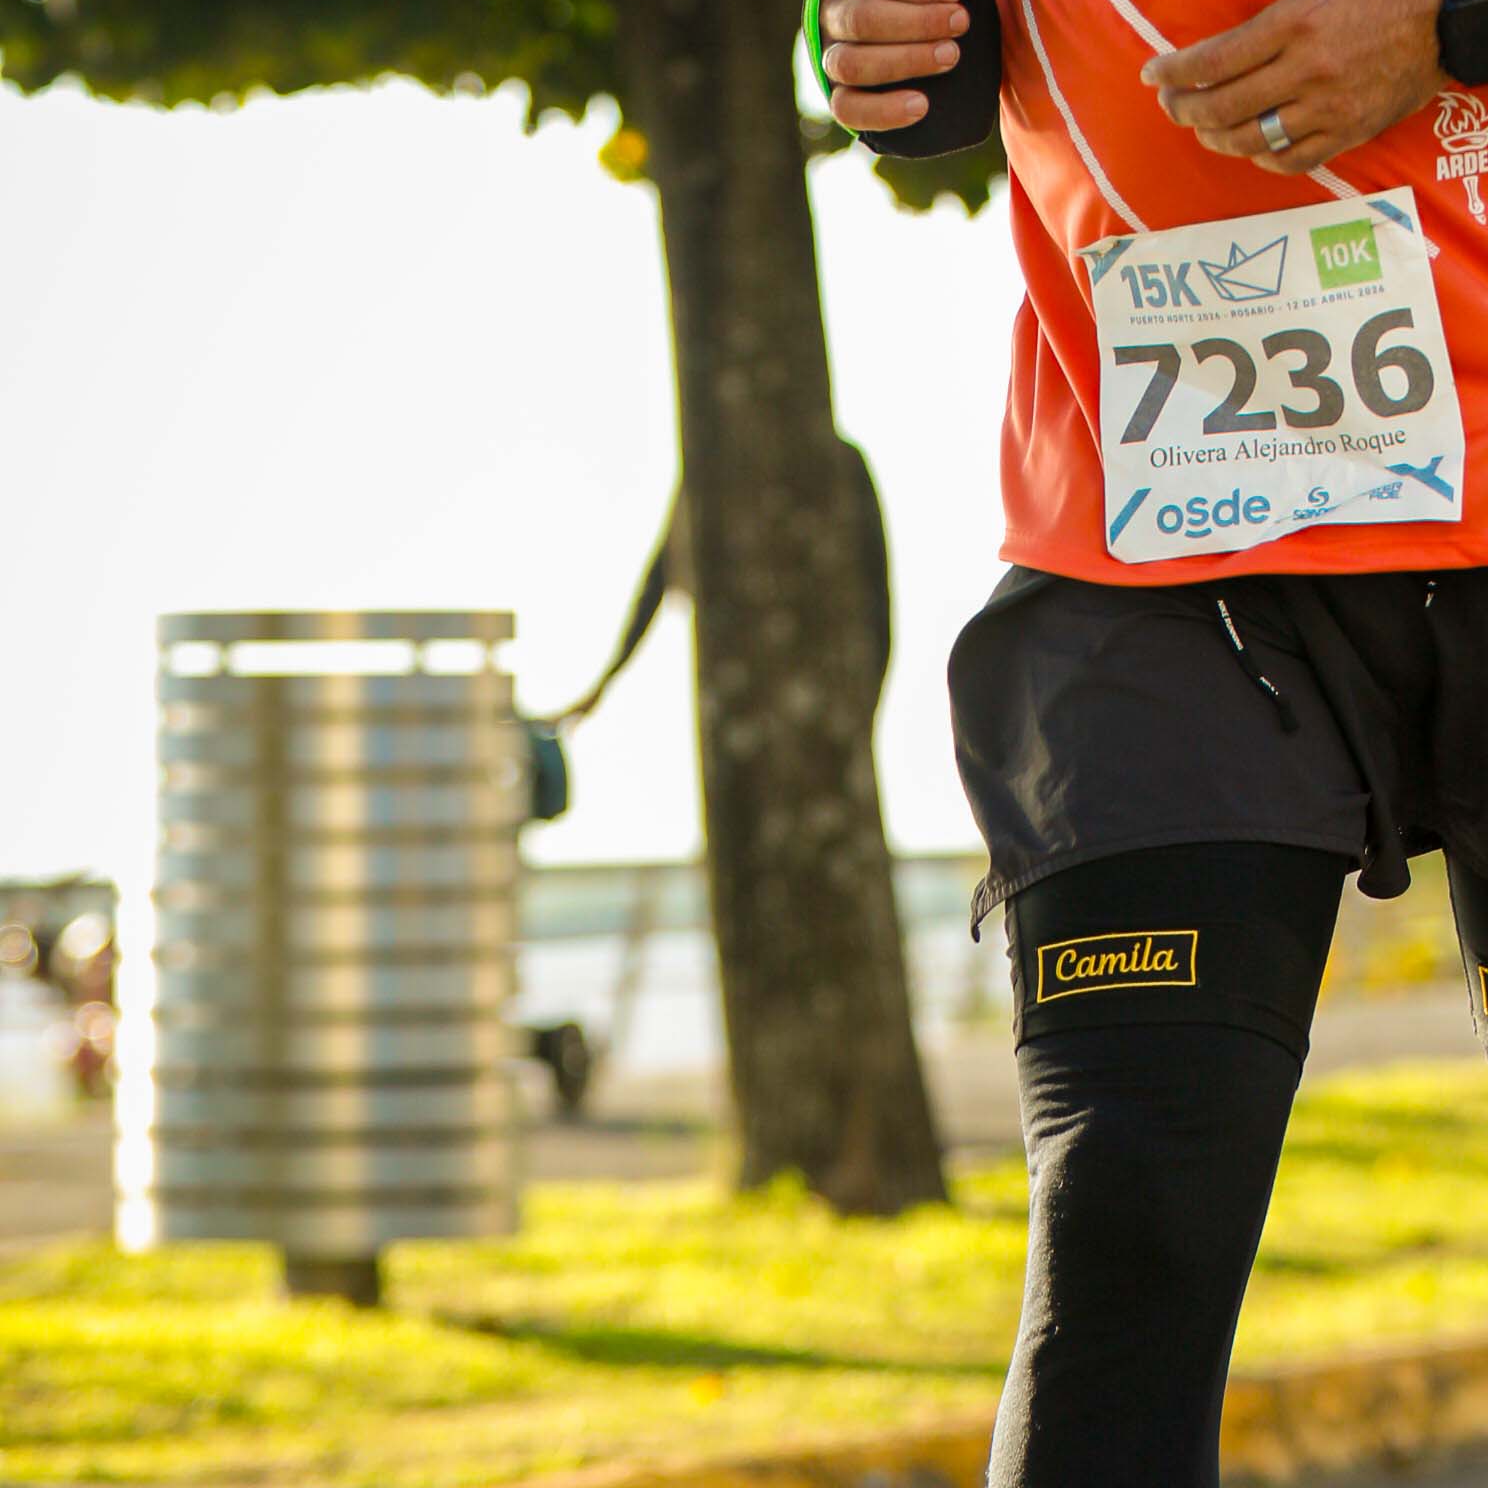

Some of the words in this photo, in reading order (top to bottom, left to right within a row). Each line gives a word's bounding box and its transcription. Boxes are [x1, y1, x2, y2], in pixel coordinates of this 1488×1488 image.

[1320, 238, 1373, 271] 10K
[1120, 262, 1202, 308] 15K
[1130, 315, 1164, 325] PUERTO
[1167, 313, 1194, 323] NORTE
[1231, 305, 1274, 318] ROSARIO
[1287, 301, 1298, 311] 12
[1303, 298, 1317, 308] DE
[1321, 292, 1354, 304] ABRIL
[1113, 308, 1434, 444] 7236
[1150, 446, 1227, 468] Olivera
[1234, 437, 1336, 462] Alejandro
[1341, 429, 1406, 454] Roque
[1157, 488, 1271, 534] osde
[1055, 936, 1179, 981] Camila
